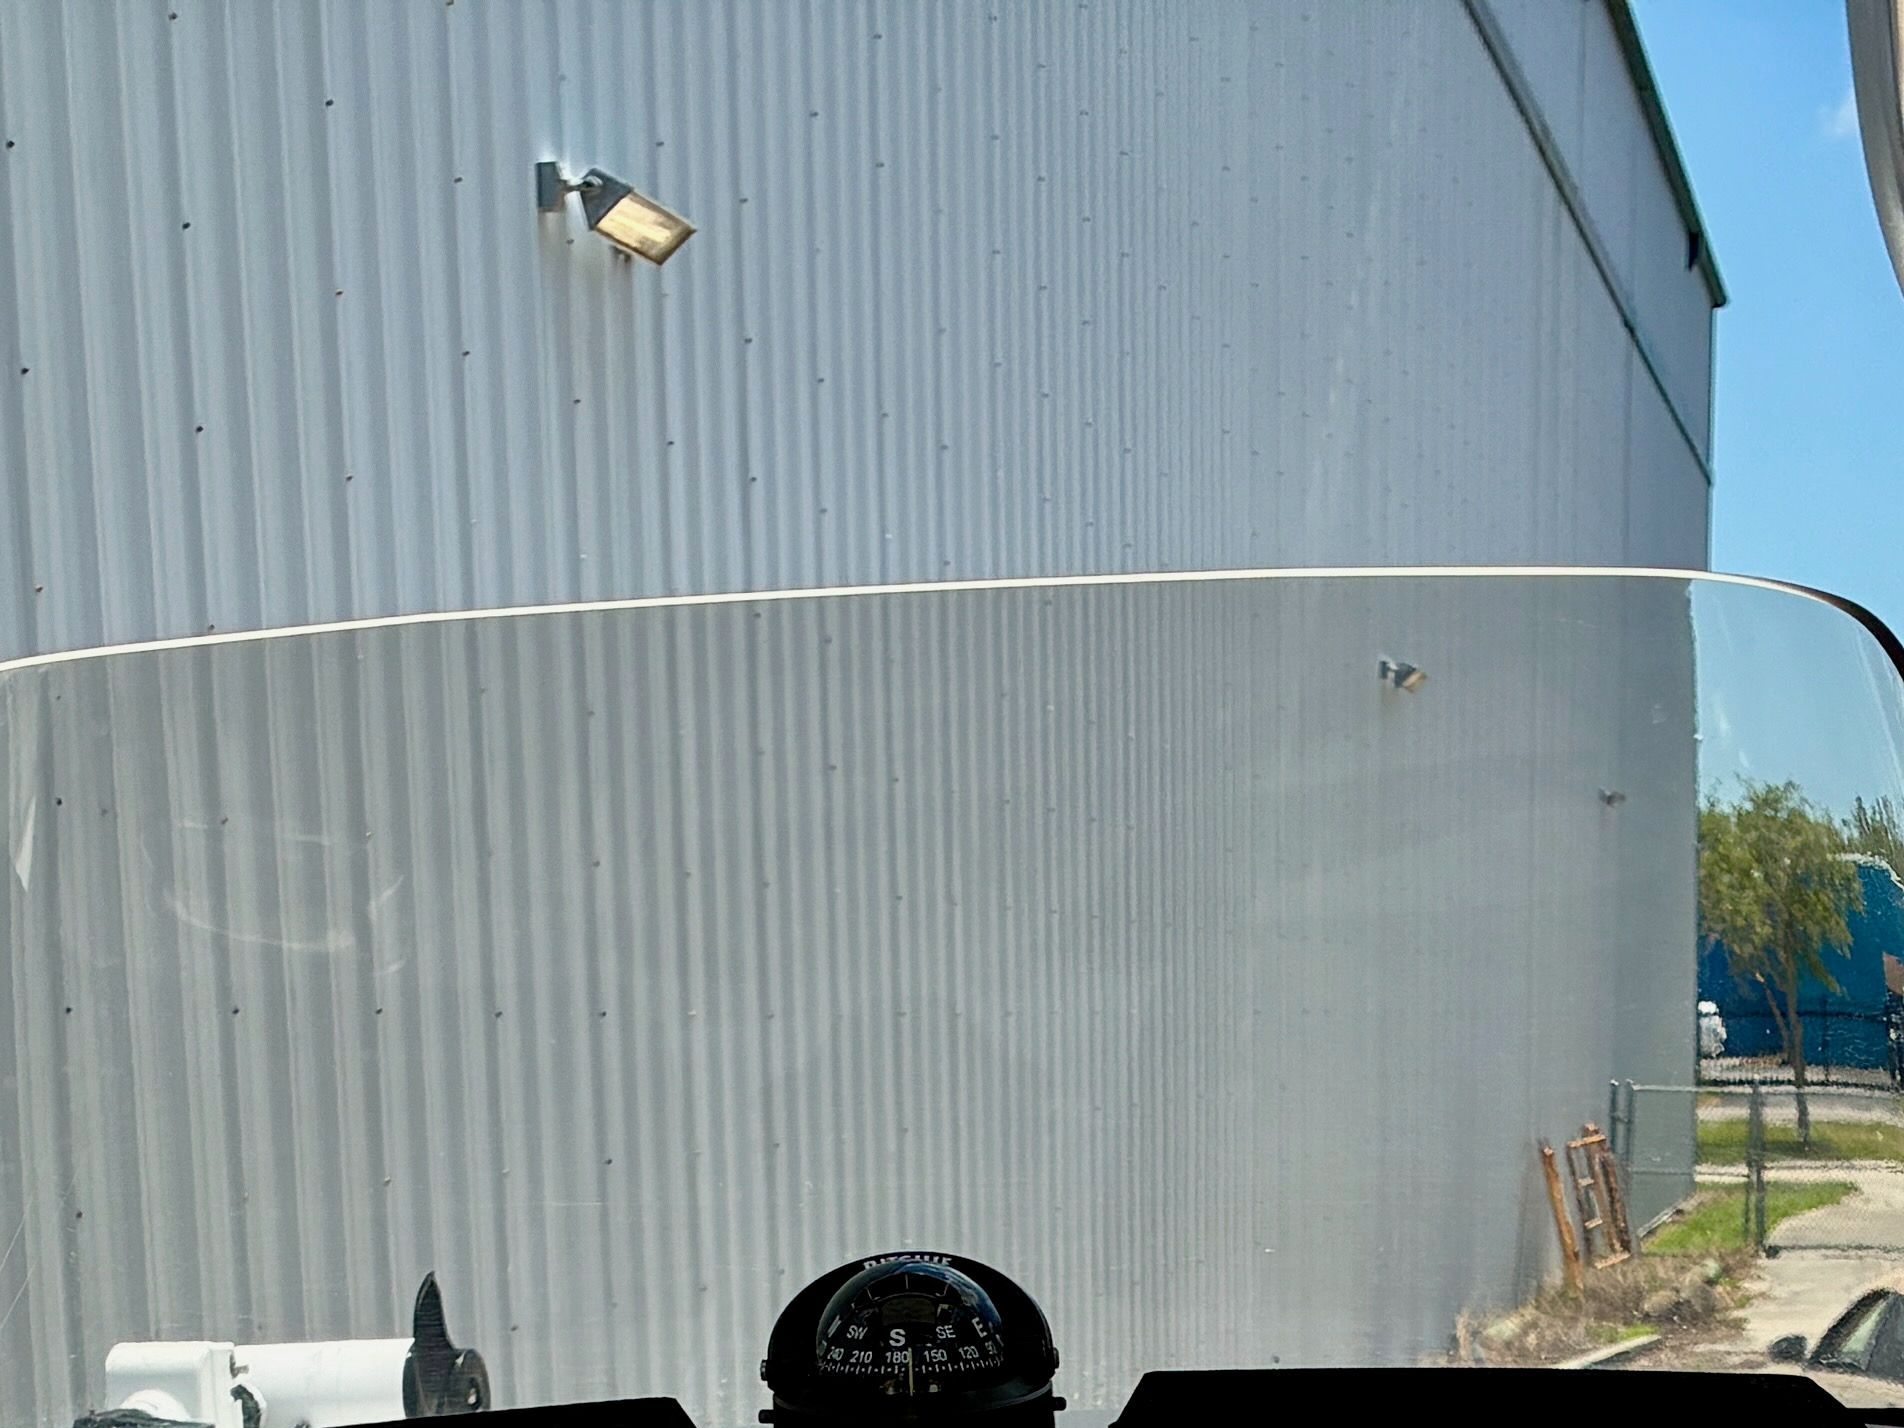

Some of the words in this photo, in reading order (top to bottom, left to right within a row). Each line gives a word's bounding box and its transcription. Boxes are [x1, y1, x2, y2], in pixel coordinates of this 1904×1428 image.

[888, 1328, 906, 1347] S
[936, 1325, 957, 1340] SE
[970, 1316, 989, 1339] E
[849, 1350, 873, 1364] 210
[885, 1350, 910, 1364] 180
[923, 1349, 948, 1362] 150
[958, 1345, 980, 1360] 120
